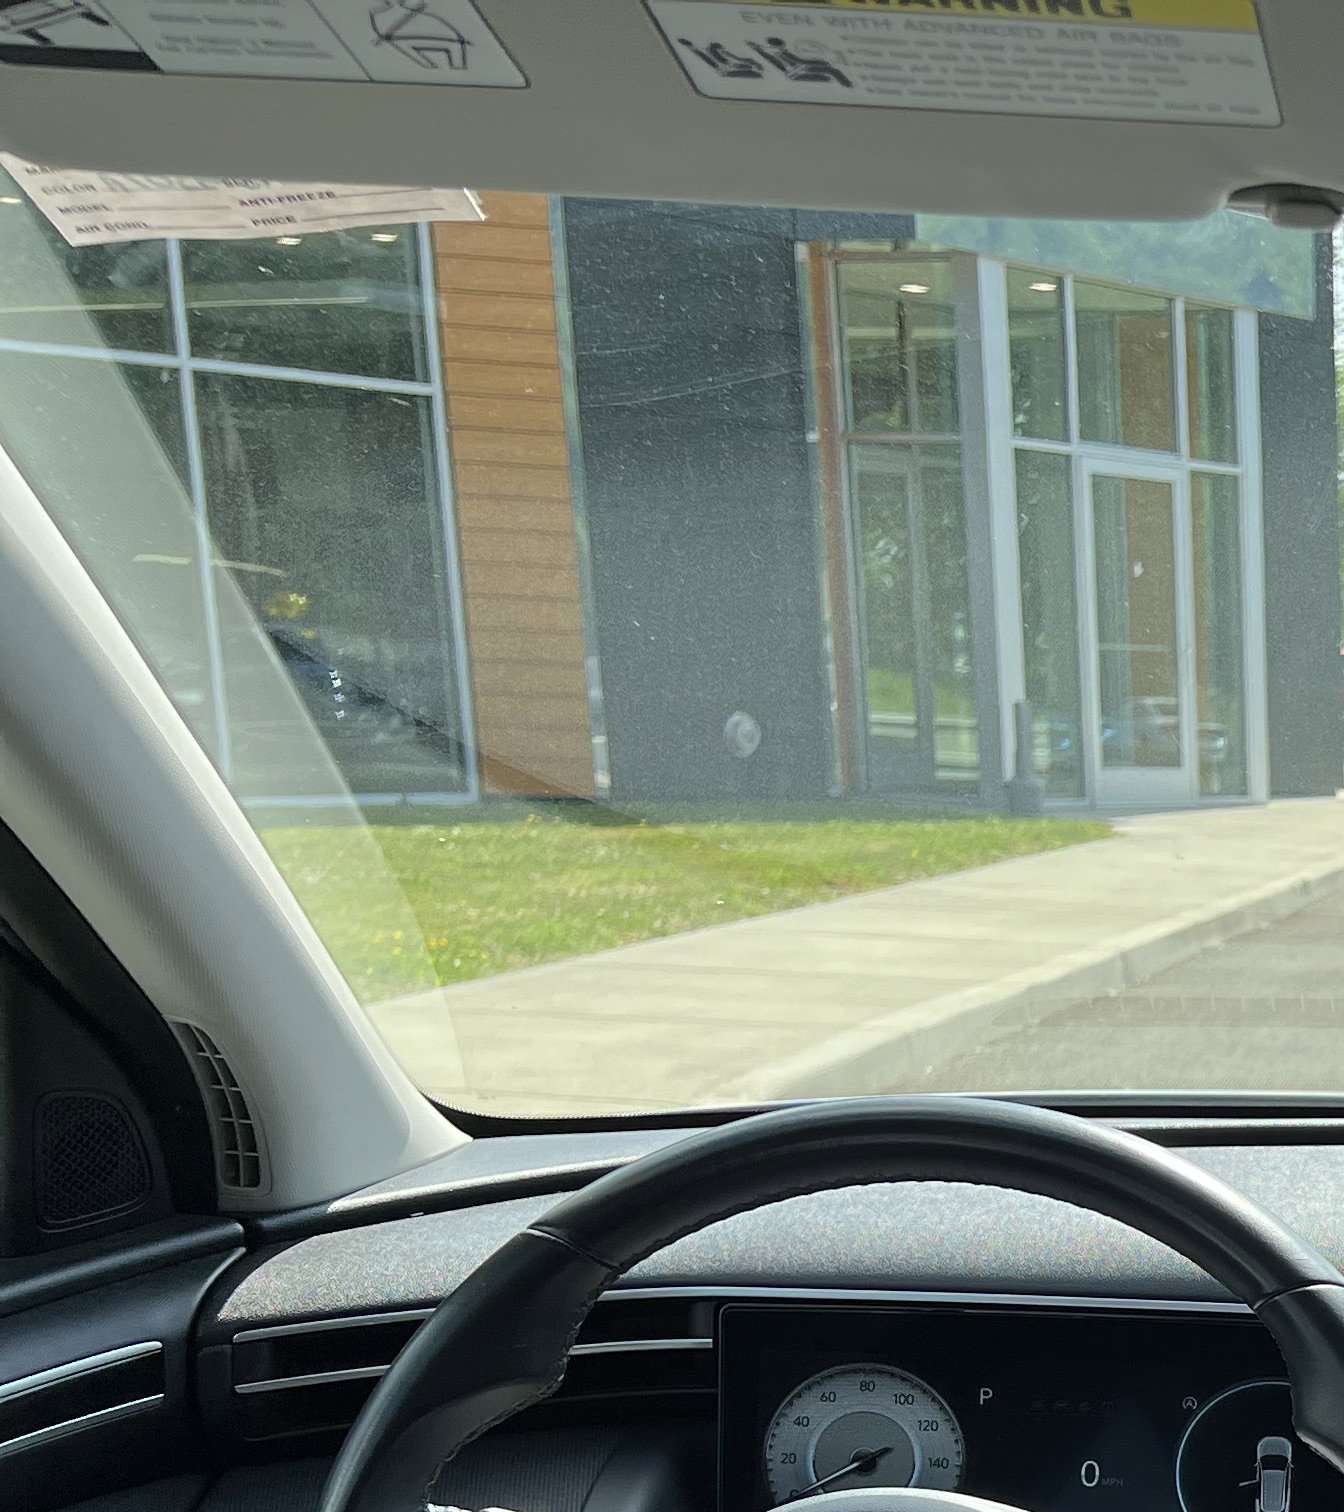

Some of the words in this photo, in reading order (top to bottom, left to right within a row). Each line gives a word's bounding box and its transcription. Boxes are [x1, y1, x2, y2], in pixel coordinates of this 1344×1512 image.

[859, 1380, 875, 1393] 80
[820, 1391, 837, 1403] 60
[893, 1393, 915, 1406] 100
[979, 1387, 993, 1405] P
[793, 1416, 810, 1428] 40
[917, 1419, 939, 1432] 120
[780, 1452, 797, 1465] 20
[928, 1456, 949, 1469] 140
[1080, 1460, 1100, 1488] 0
